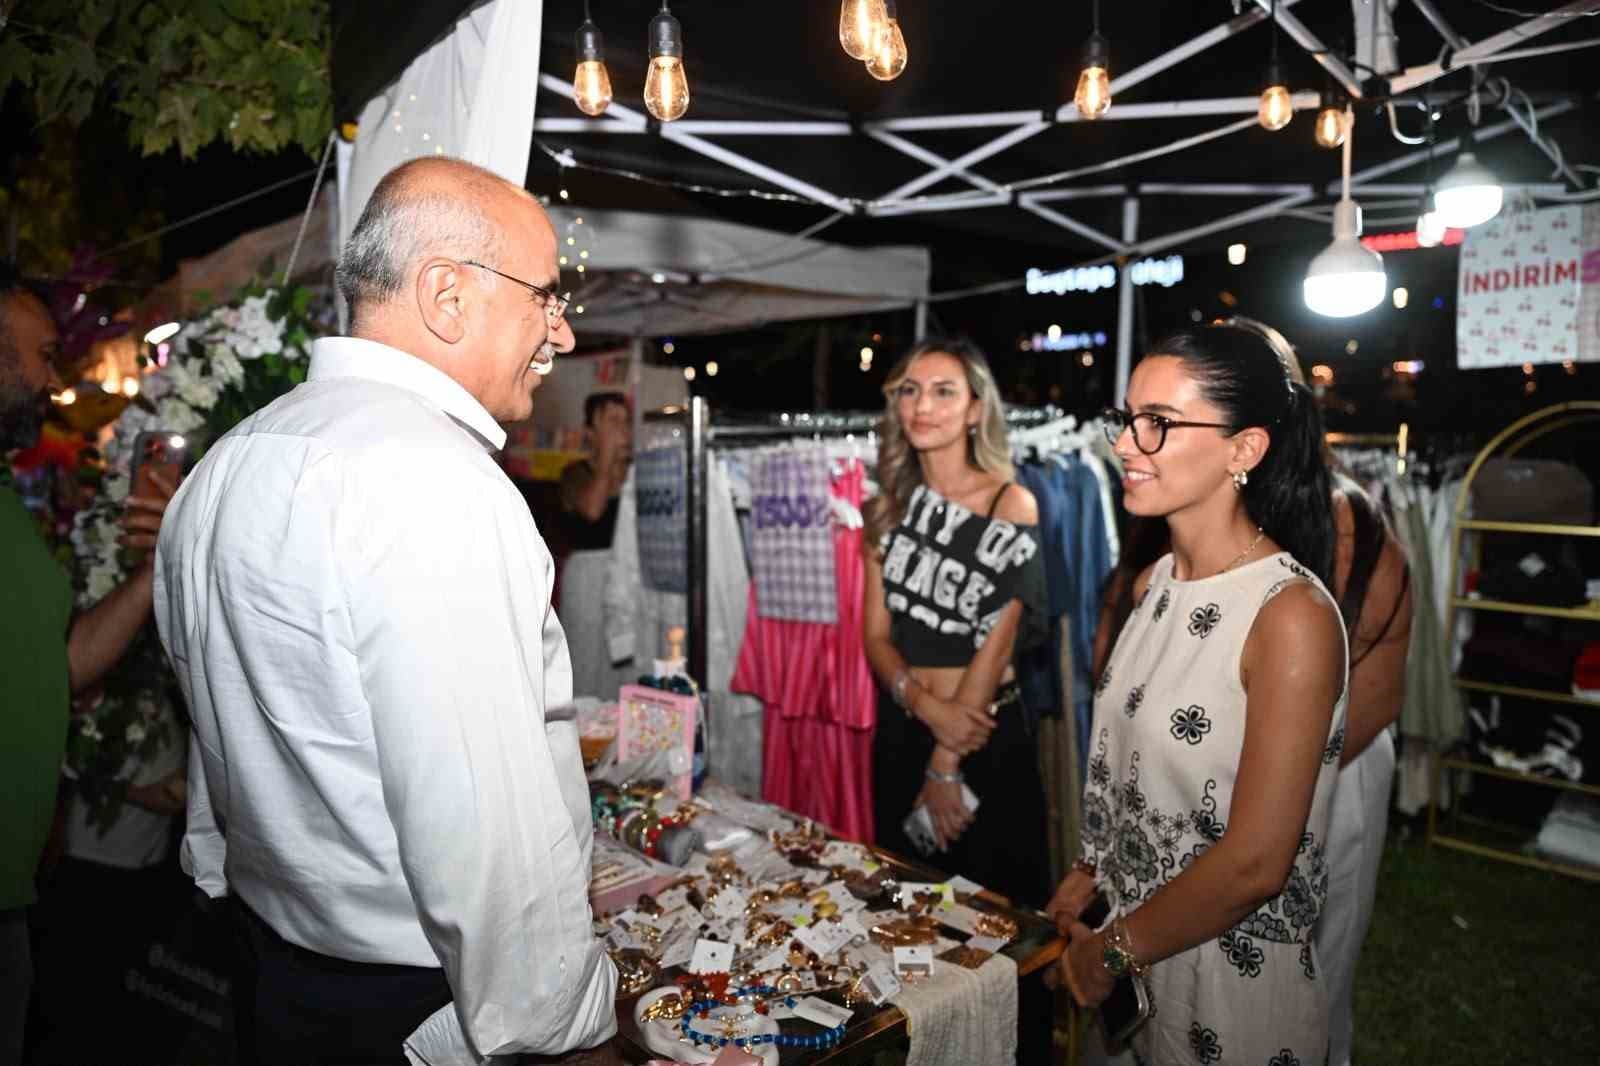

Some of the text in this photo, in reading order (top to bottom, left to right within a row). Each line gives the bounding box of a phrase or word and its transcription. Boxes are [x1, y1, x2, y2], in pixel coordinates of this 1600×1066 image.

[1463, 256, 1577, 296] İNDİRİM
[902, 484, 1037, 573] ITY OF
